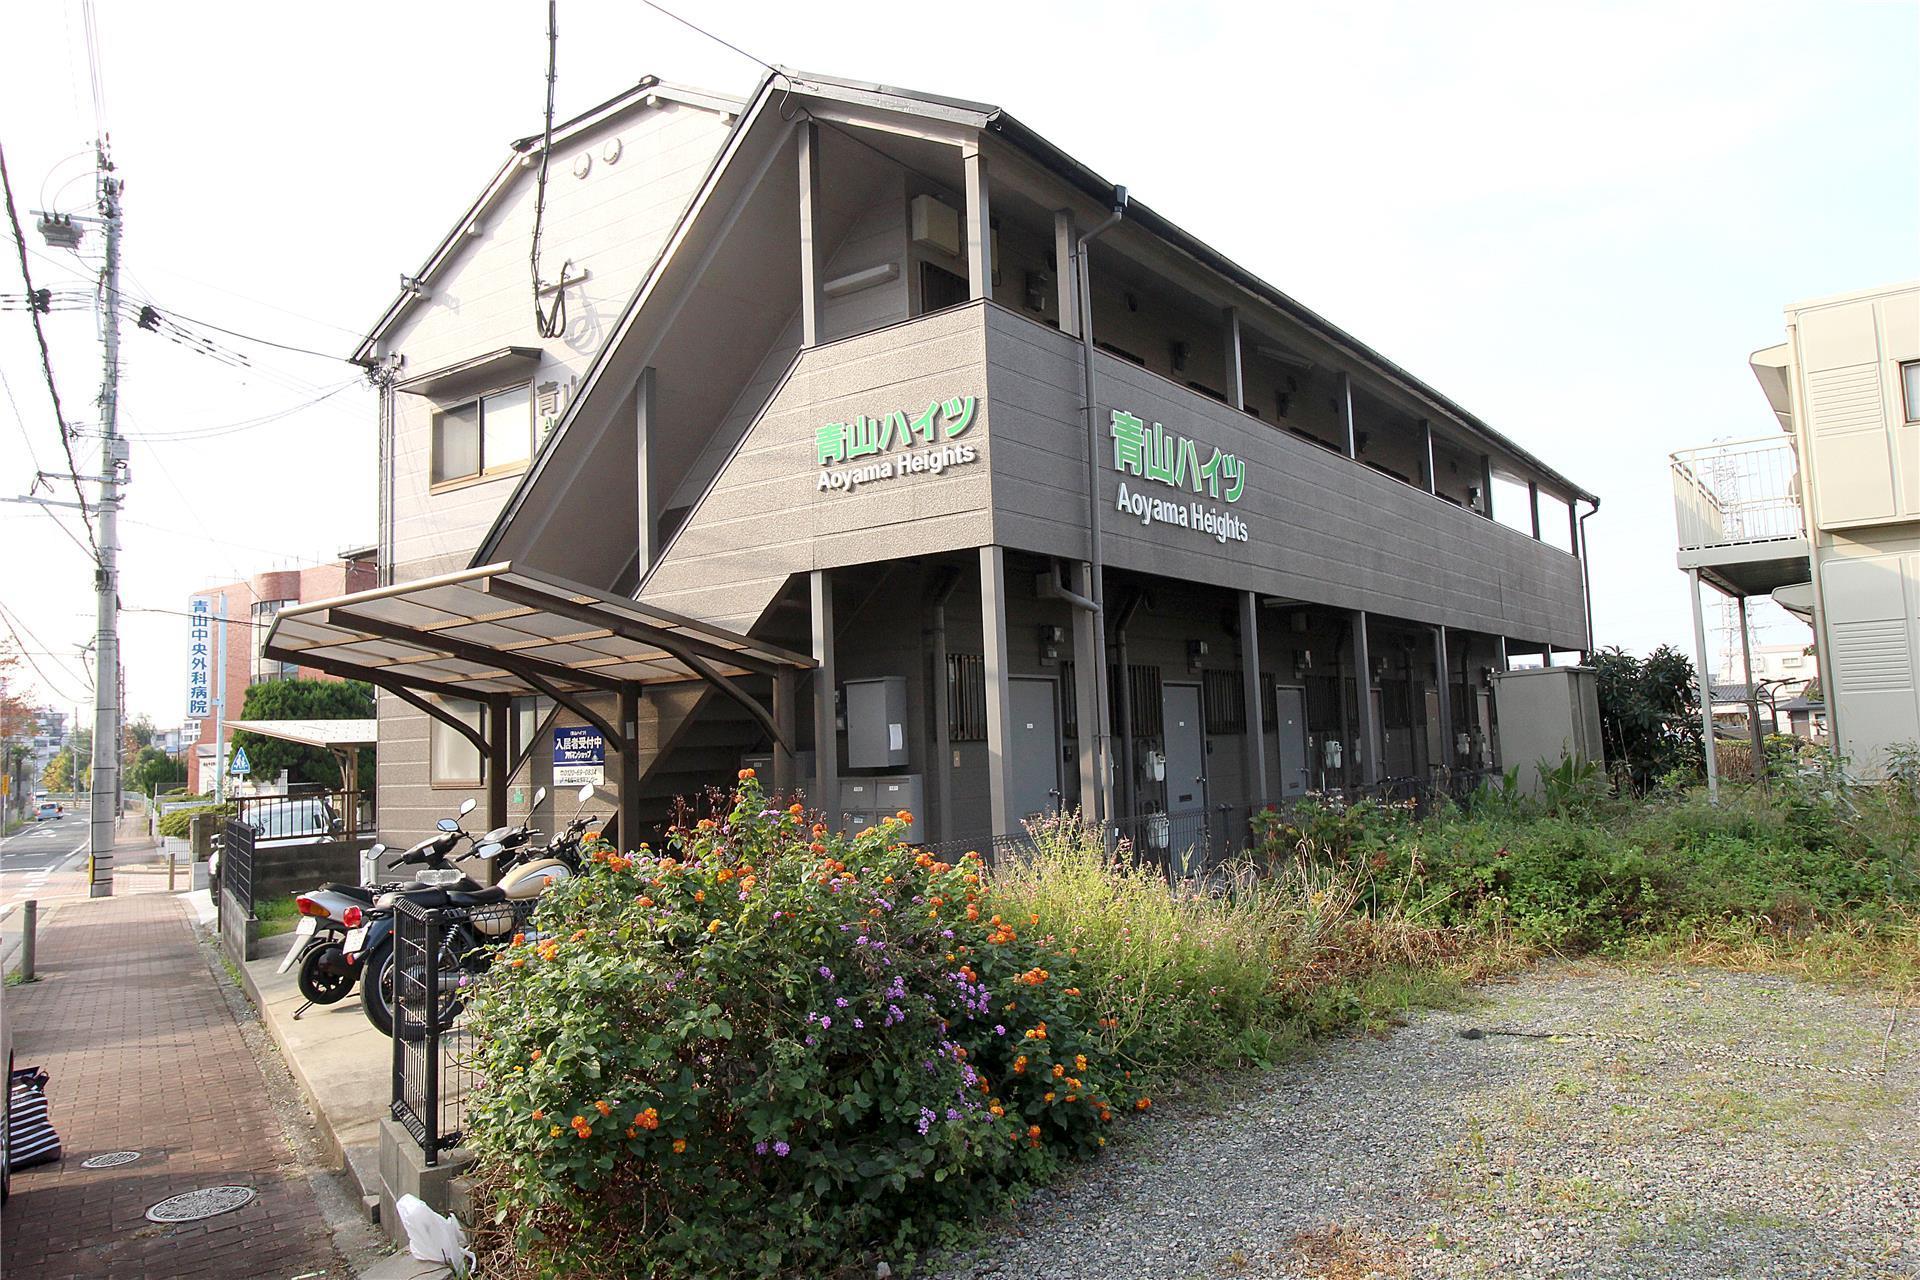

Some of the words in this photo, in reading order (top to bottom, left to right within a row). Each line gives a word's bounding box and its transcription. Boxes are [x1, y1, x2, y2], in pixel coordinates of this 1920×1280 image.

[815, 395, 976, 466] 青山ハイツ
[1110, 409, 1245, 503] 青山ハイツ
[817, 461, 894, 491] Aoyama
[897, 445, 976, 475] Heights
[1116, 482, 1188, 525] Aoyama
[1190, 502, 1248, 543] Heights
[190, 600, 208, 713] 青山中央外科病院
[555, 736, 602, 750] 入居者受付中
